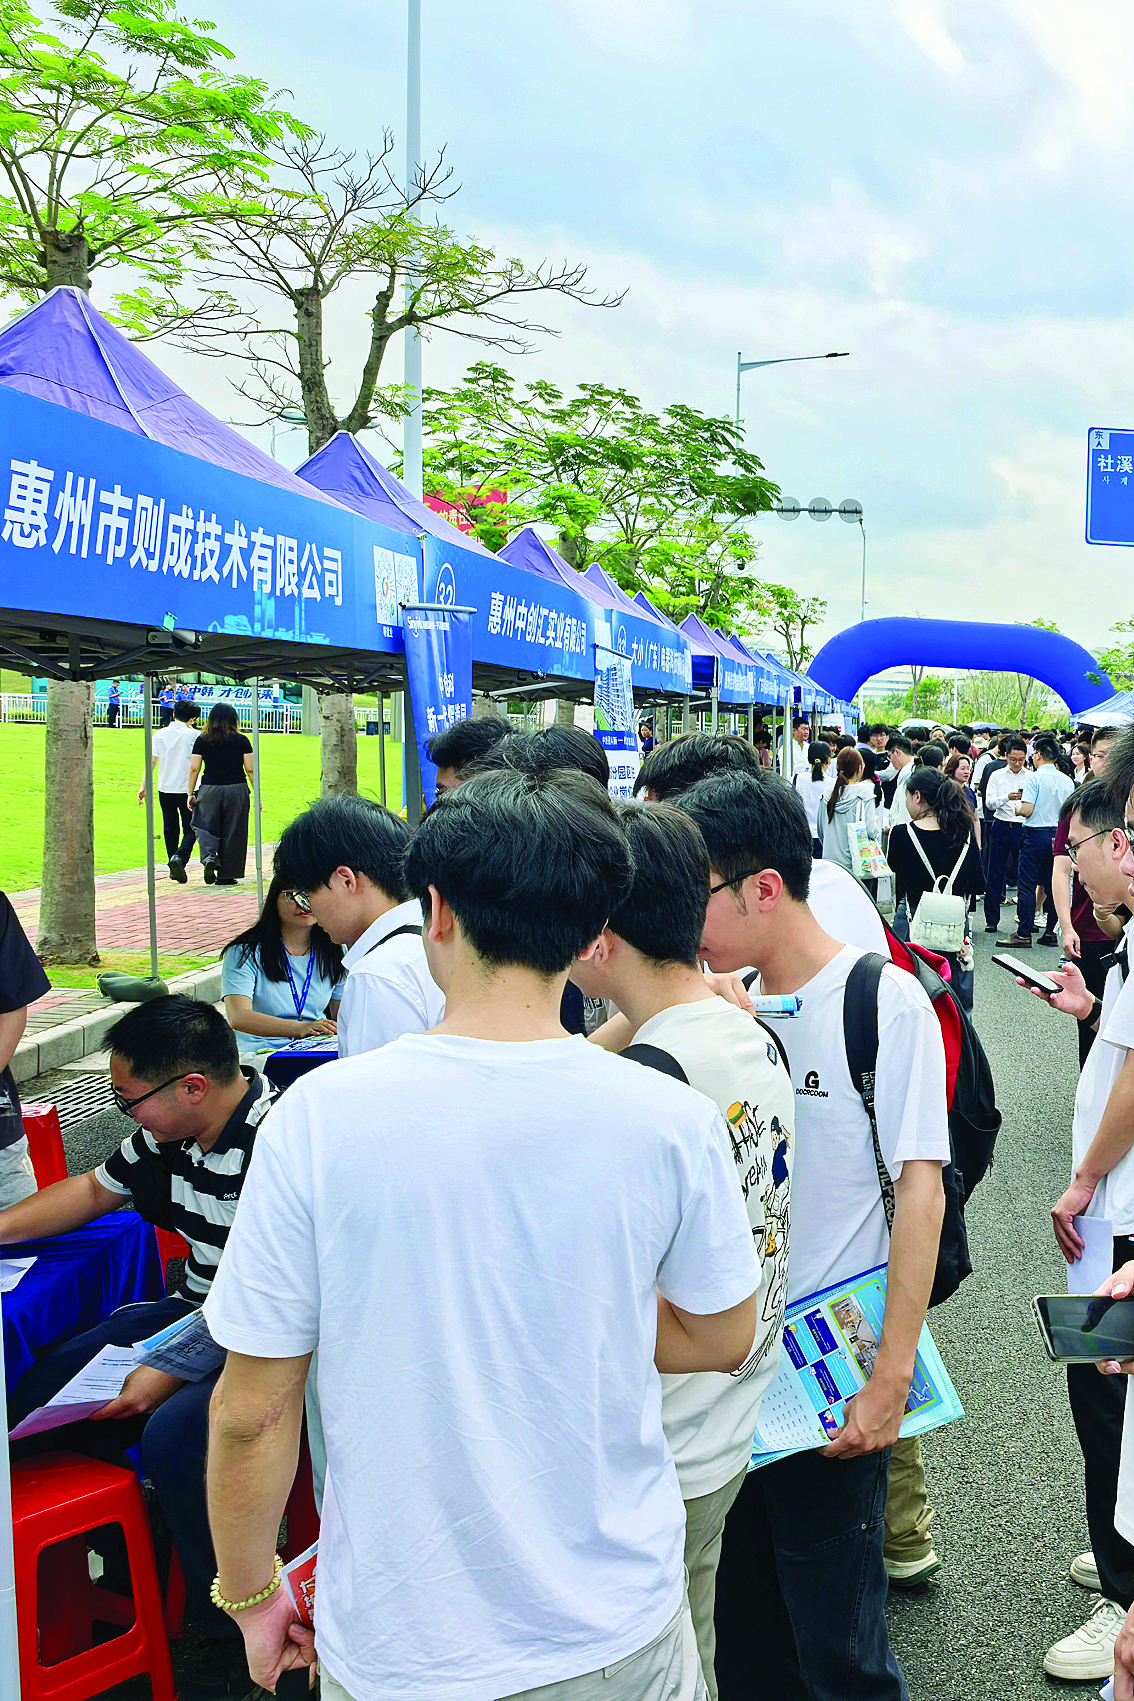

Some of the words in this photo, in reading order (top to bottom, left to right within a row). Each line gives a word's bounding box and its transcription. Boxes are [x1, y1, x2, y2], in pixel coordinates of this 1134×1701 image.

[1, 457, 344, 606] 惠州市则成技术有限公司
[487, 590, 587, 657] 惠州中创汇实业有限公司
[804, 1070, 820, 1090] G
